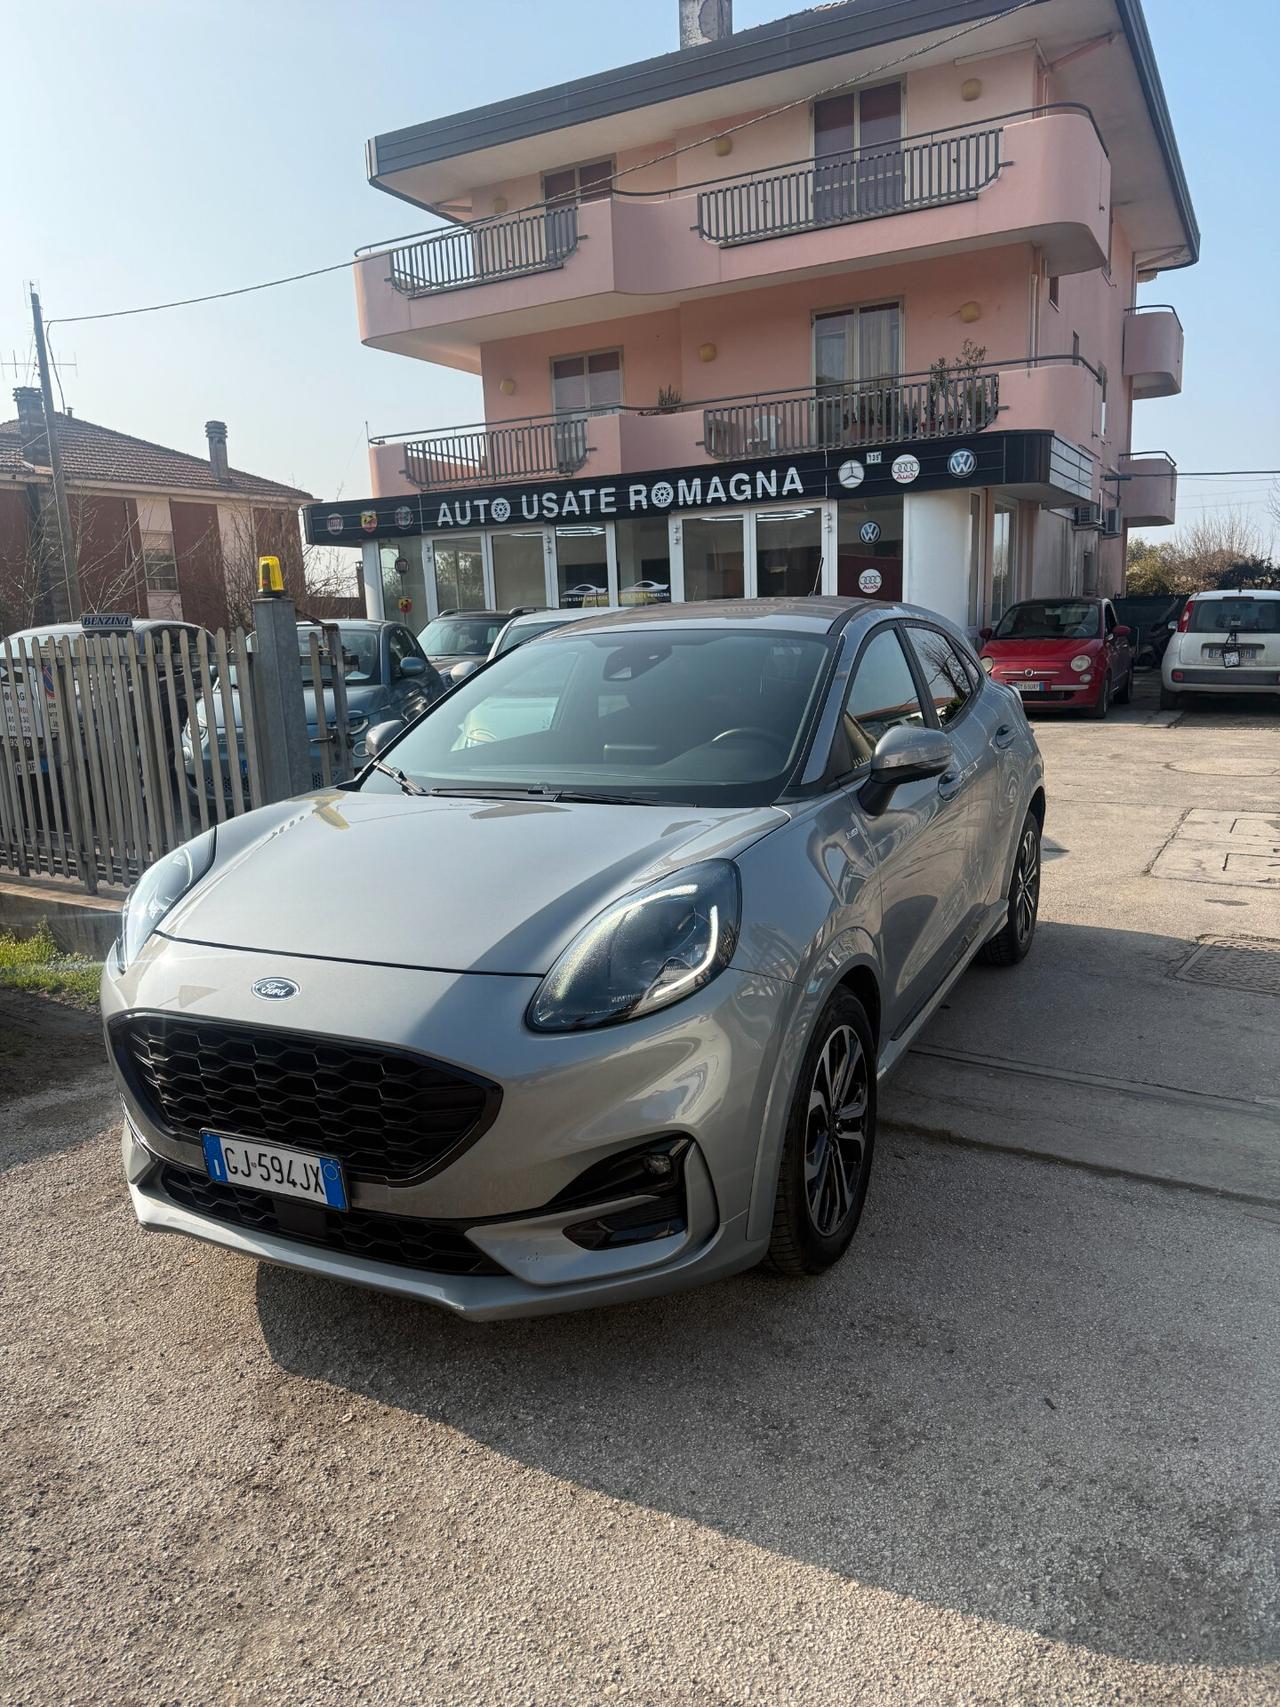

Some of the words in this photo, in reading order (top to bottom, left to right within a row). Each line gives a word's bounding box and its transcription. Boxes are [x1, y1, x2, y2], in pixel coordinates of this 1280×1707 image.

[437, 497, 511, 527] AUTO
[521, 486, 618, 520] USATE
[629, 466, 804, 511] ROMAGNA
[84, 616, 129, 626] BENZINA
[261, 982, 290, 996] Ford
